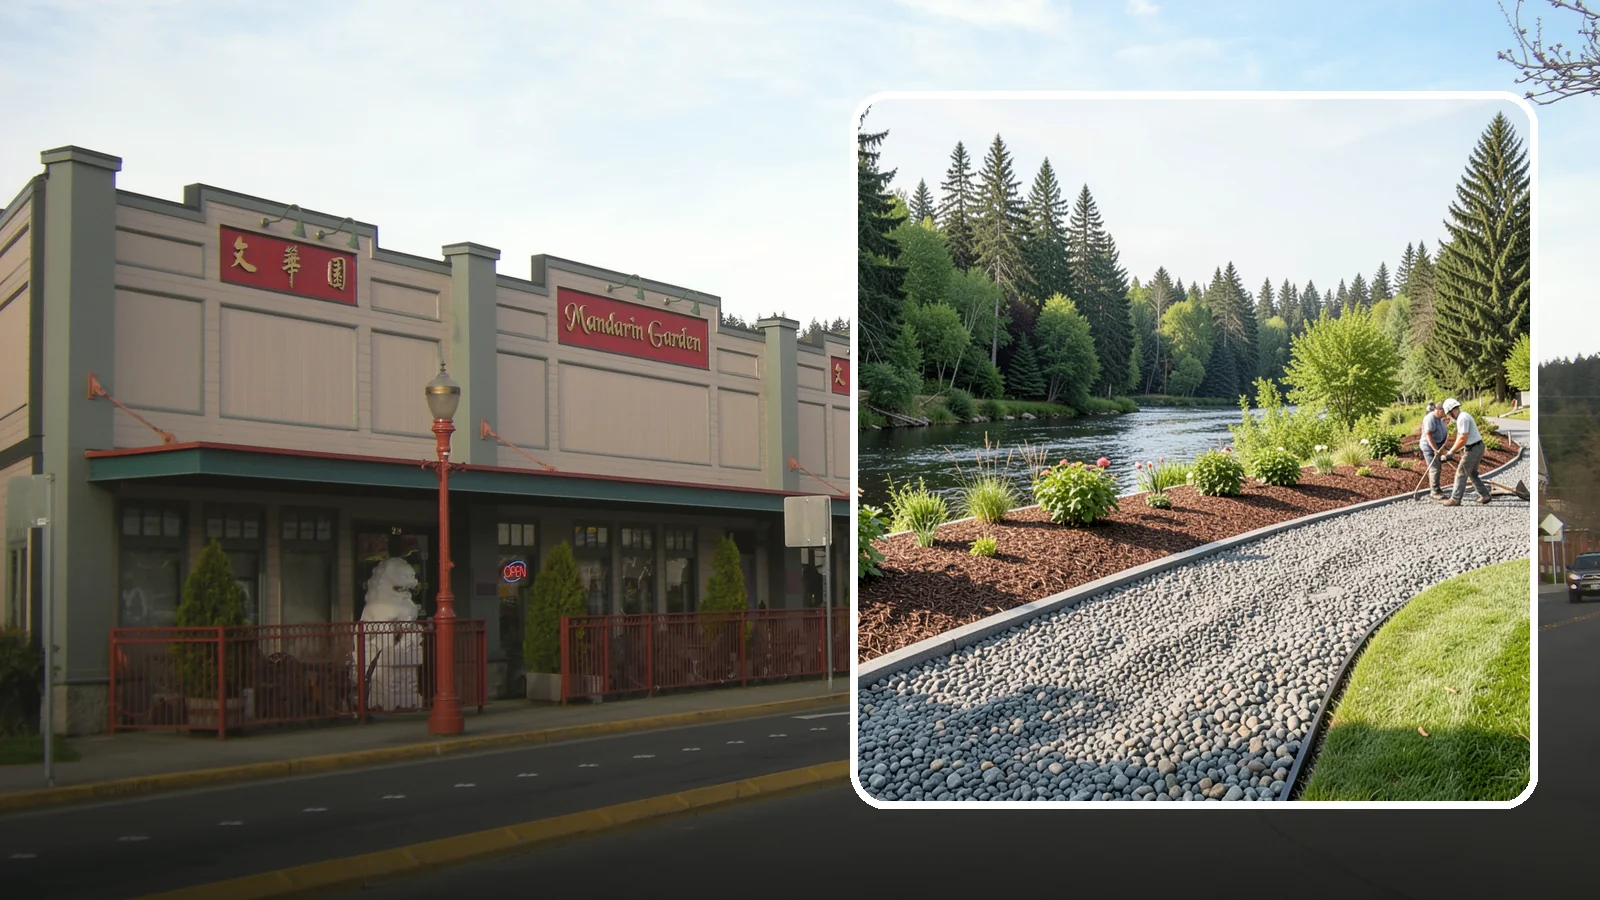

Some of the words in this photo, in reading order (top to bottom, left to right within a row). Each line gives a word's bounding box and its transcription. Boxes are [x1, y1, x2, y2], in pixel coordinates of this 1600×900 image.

[231, 236, 346, 291] 文華園
[564, 302, 644, 341] Mandarin
[648, 320, 702, 352] Garden
[503, 565, 527, 578] OPEN
